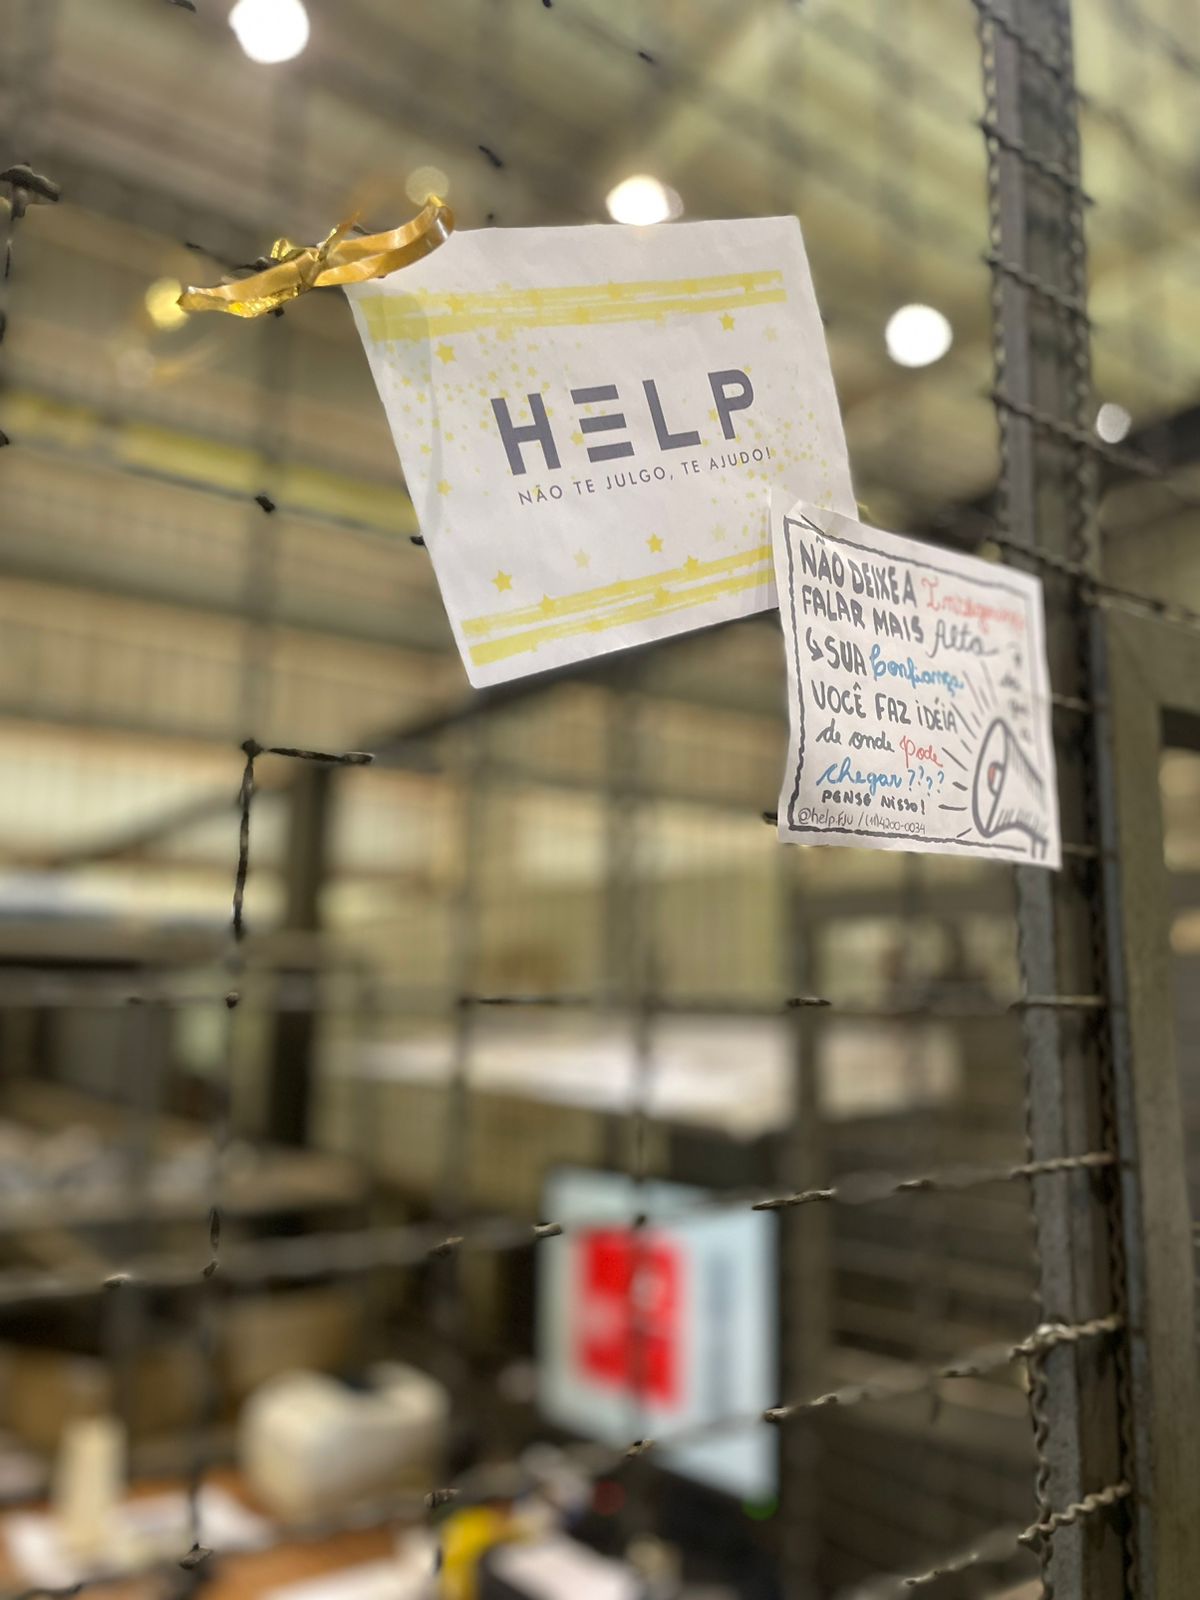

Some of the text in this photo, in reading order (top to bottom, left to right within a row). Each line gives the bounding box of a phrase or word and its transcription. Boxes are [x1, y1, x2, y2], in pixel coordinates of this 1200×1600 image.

[490, 368, 755, 476] HELP
[518, 446, 772, 506] NÃO TE JULGO, TE AJUDO!
[800, 535, 845, 588] NÃO
[847, 558, 900, 605] DEIXE
[902, 570, 917, 608] A
[802, 584, 866, 630] FALAR
[872, 607, 924, 644] MAIS
[824, 635, 868, 676] SUA
[811, 679, 867, 719] VOCÊ
[874, 692, 911, 725] FAZ
[815, 718, 842, 745] de
[848, 730, 895, 753] onde
